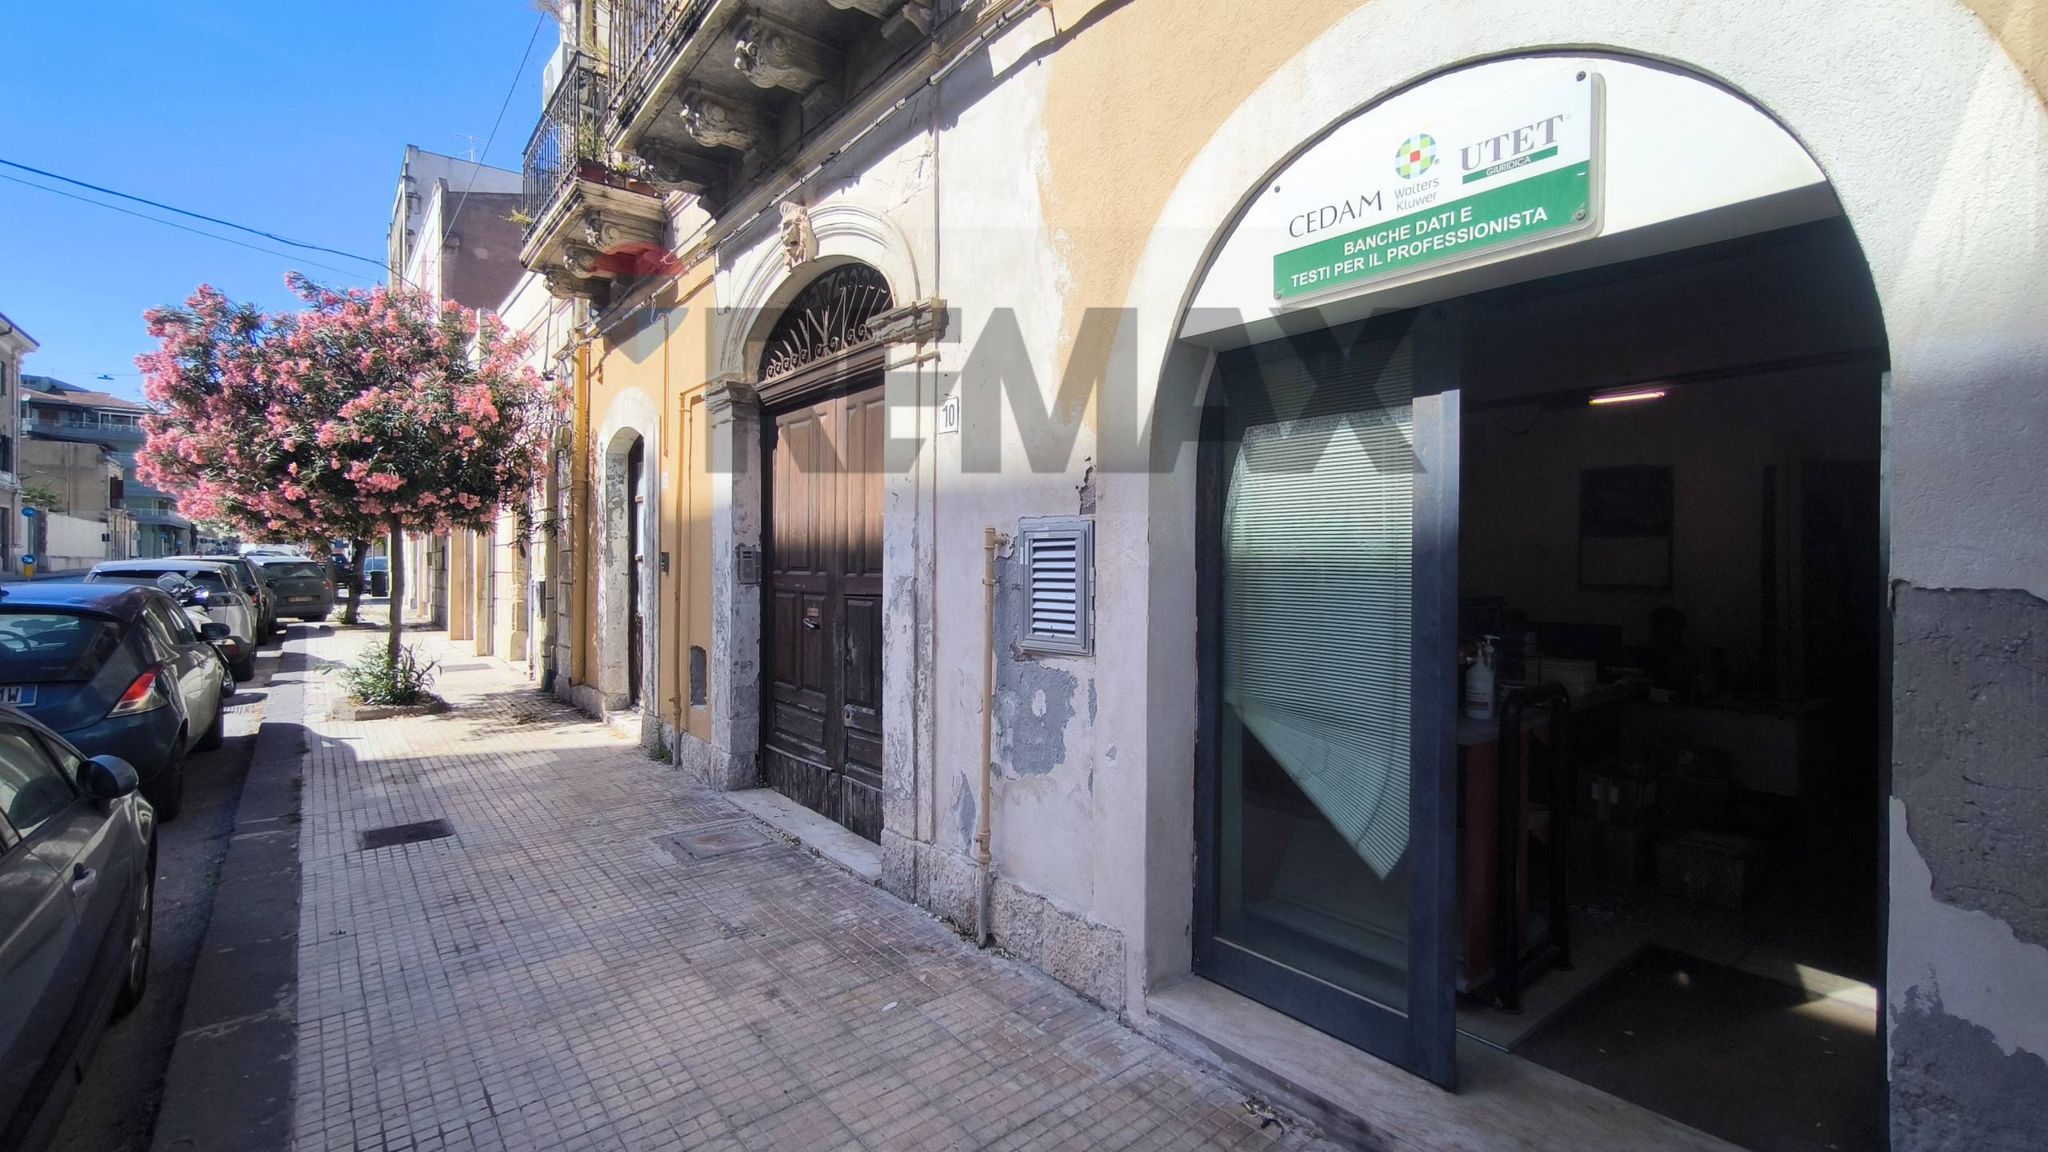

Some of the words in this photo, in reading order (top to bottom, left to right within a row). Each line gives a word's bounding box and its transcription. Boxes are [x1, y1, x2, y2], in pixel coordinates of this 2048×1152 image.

[1459, 114, 1563, 171] UTET
[1486, 156, 1532, 176] GIURIDICA
[1394, 177, 1440, 199] Wolters
[1396, 192, 1438, 212] Kluwer
[1289, 190, 1382, 238] CEDAM
[1344, 224, 1411, 256] BANCHE
[1415, 211, 1455, 236] DATI
[1460, 206, 1473, 223] E
[1290, 266, 1330, 288] TESTI
[1334, 257, 1365, 277] PER
[1369, 253, 1383, 267] IL
[1387, 206, 1548, 263] PROFESSIONISTA
[942, 404, 955, 428] 10
